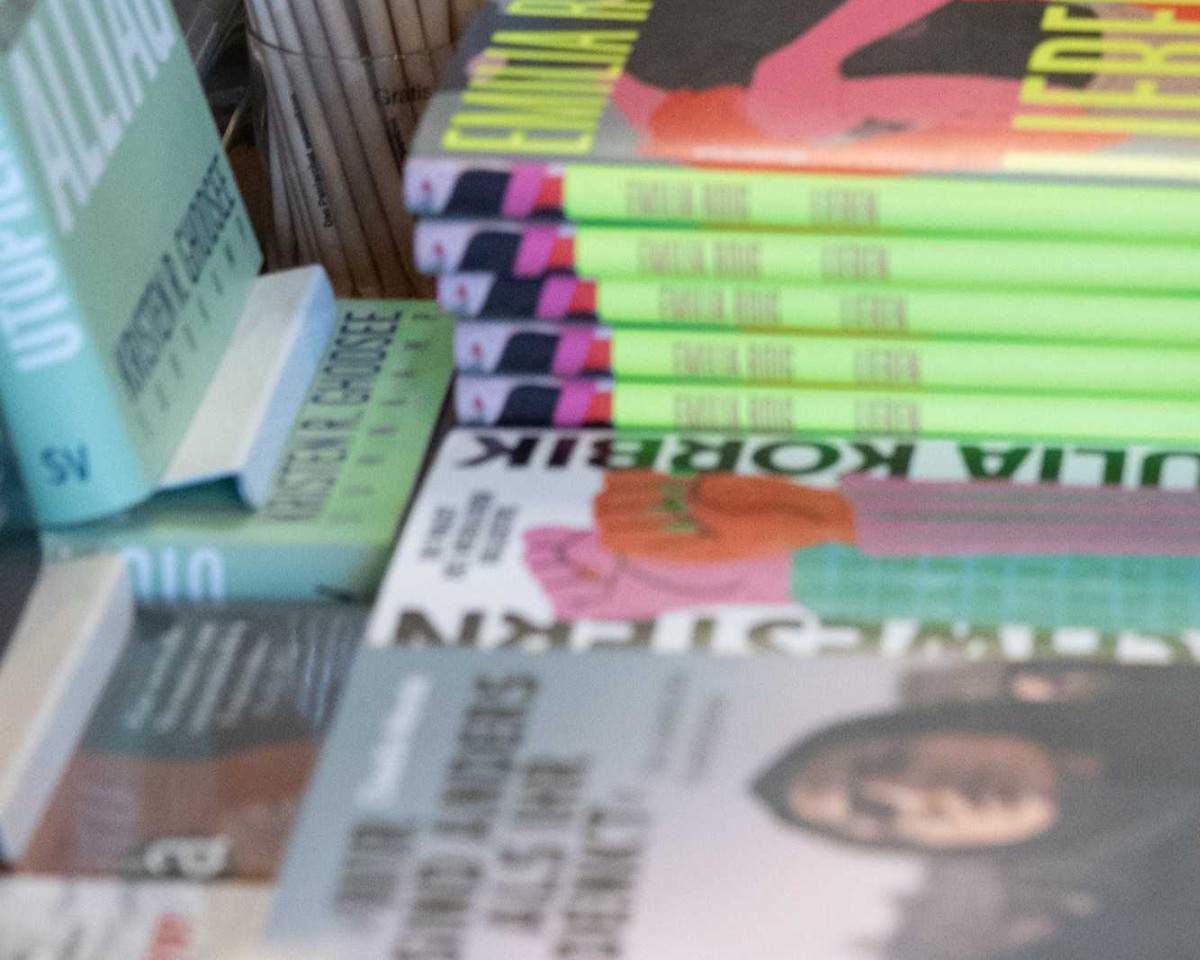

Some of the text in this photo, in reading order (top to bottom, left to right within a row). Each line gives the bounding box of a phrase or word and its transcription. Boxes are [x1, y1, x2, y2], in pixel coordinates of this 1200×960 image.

[441, 29, 640, 154] EMILIA
[40, 446, 91, 485] SV
[457, 432, 926, 480] KORBIK
